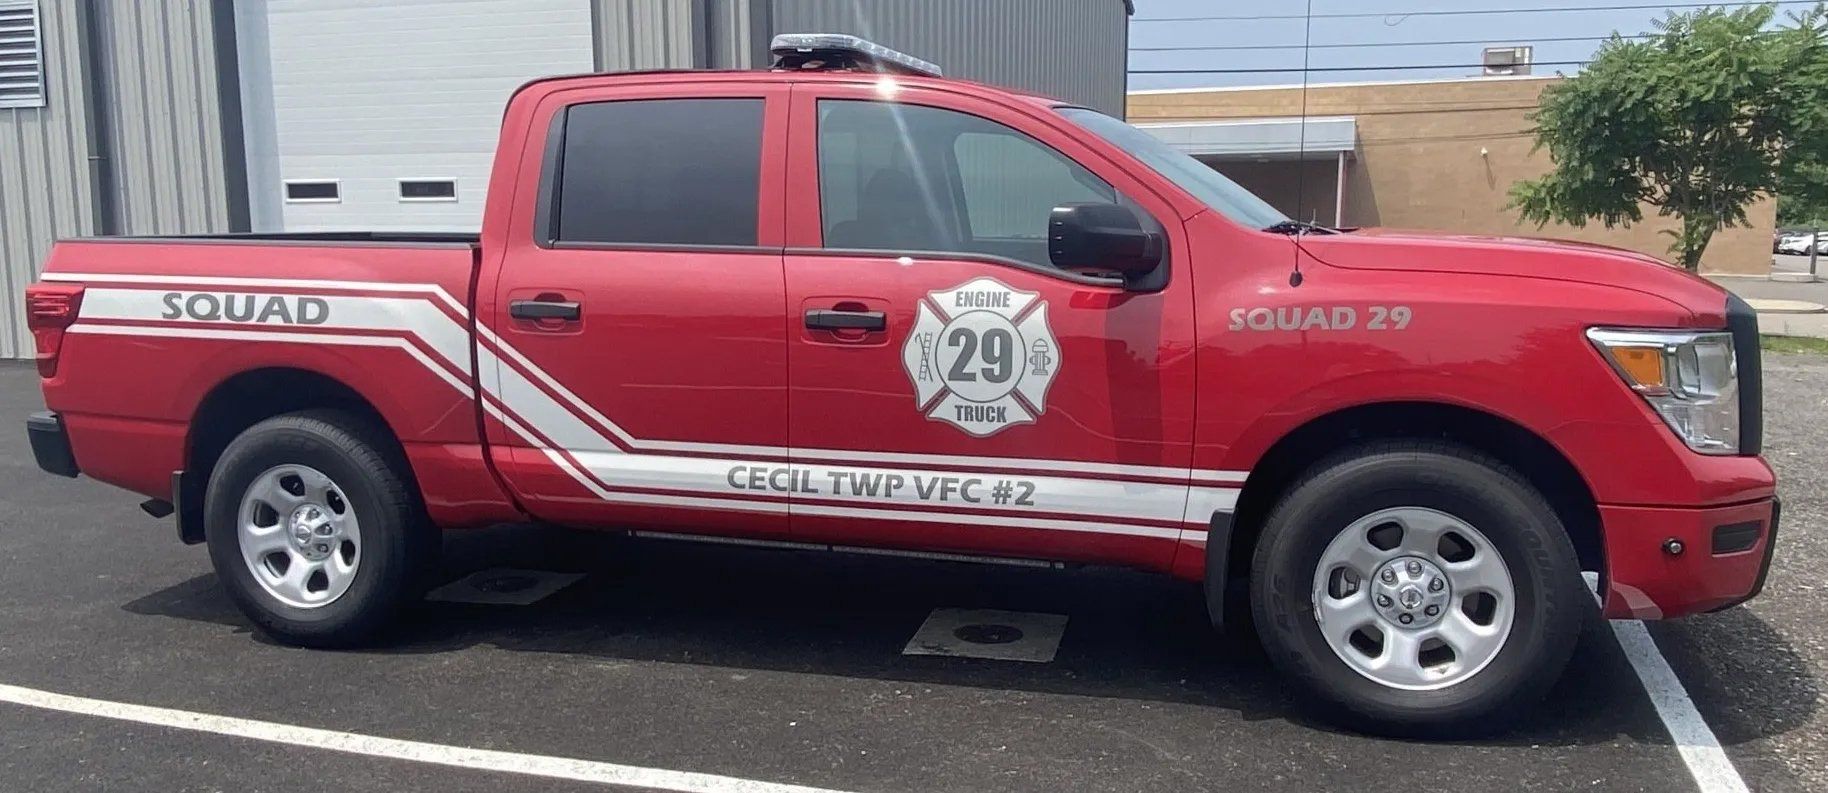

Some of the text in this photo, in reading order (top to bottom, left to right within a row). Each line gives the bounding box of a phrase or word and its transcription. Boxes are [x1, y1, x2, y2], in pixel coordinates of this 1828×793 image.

[162, 292, 330, 325] SQUAD
[955, 291, 1011, 308] ENGINE
[1228, 306, 1412, 331] SQUAD 29
[948, 327, 1013, 383] 29
[954, 405, 1007, 423] TRUCK
[727, 465, 1036, 506] CECIL TWP VFC #2
